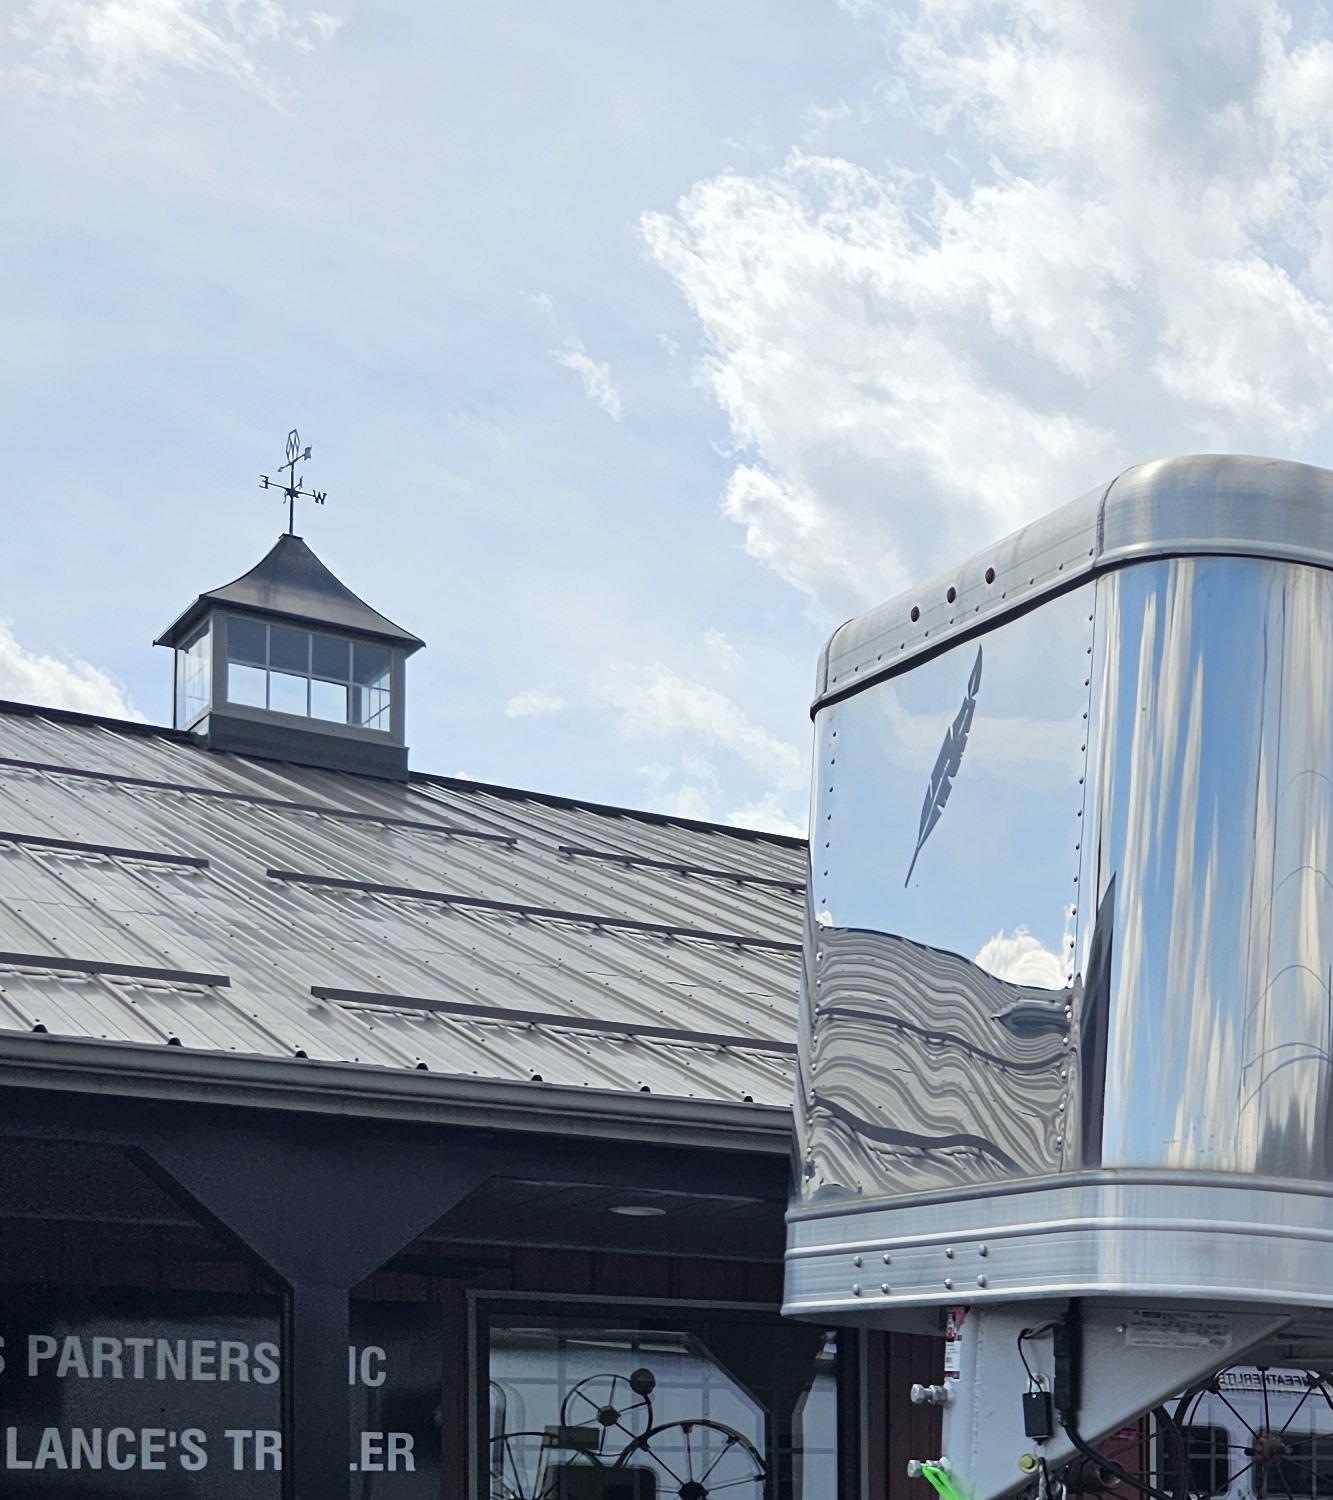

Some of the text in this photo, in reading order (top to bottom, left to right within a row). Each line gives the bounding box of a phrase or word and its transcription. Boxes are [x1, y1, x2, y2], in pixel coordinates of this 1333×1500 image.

[28, 1334, 281, 1385] PARTNERS
[6, 1426, 416, 1472] LANCE'S TRER
